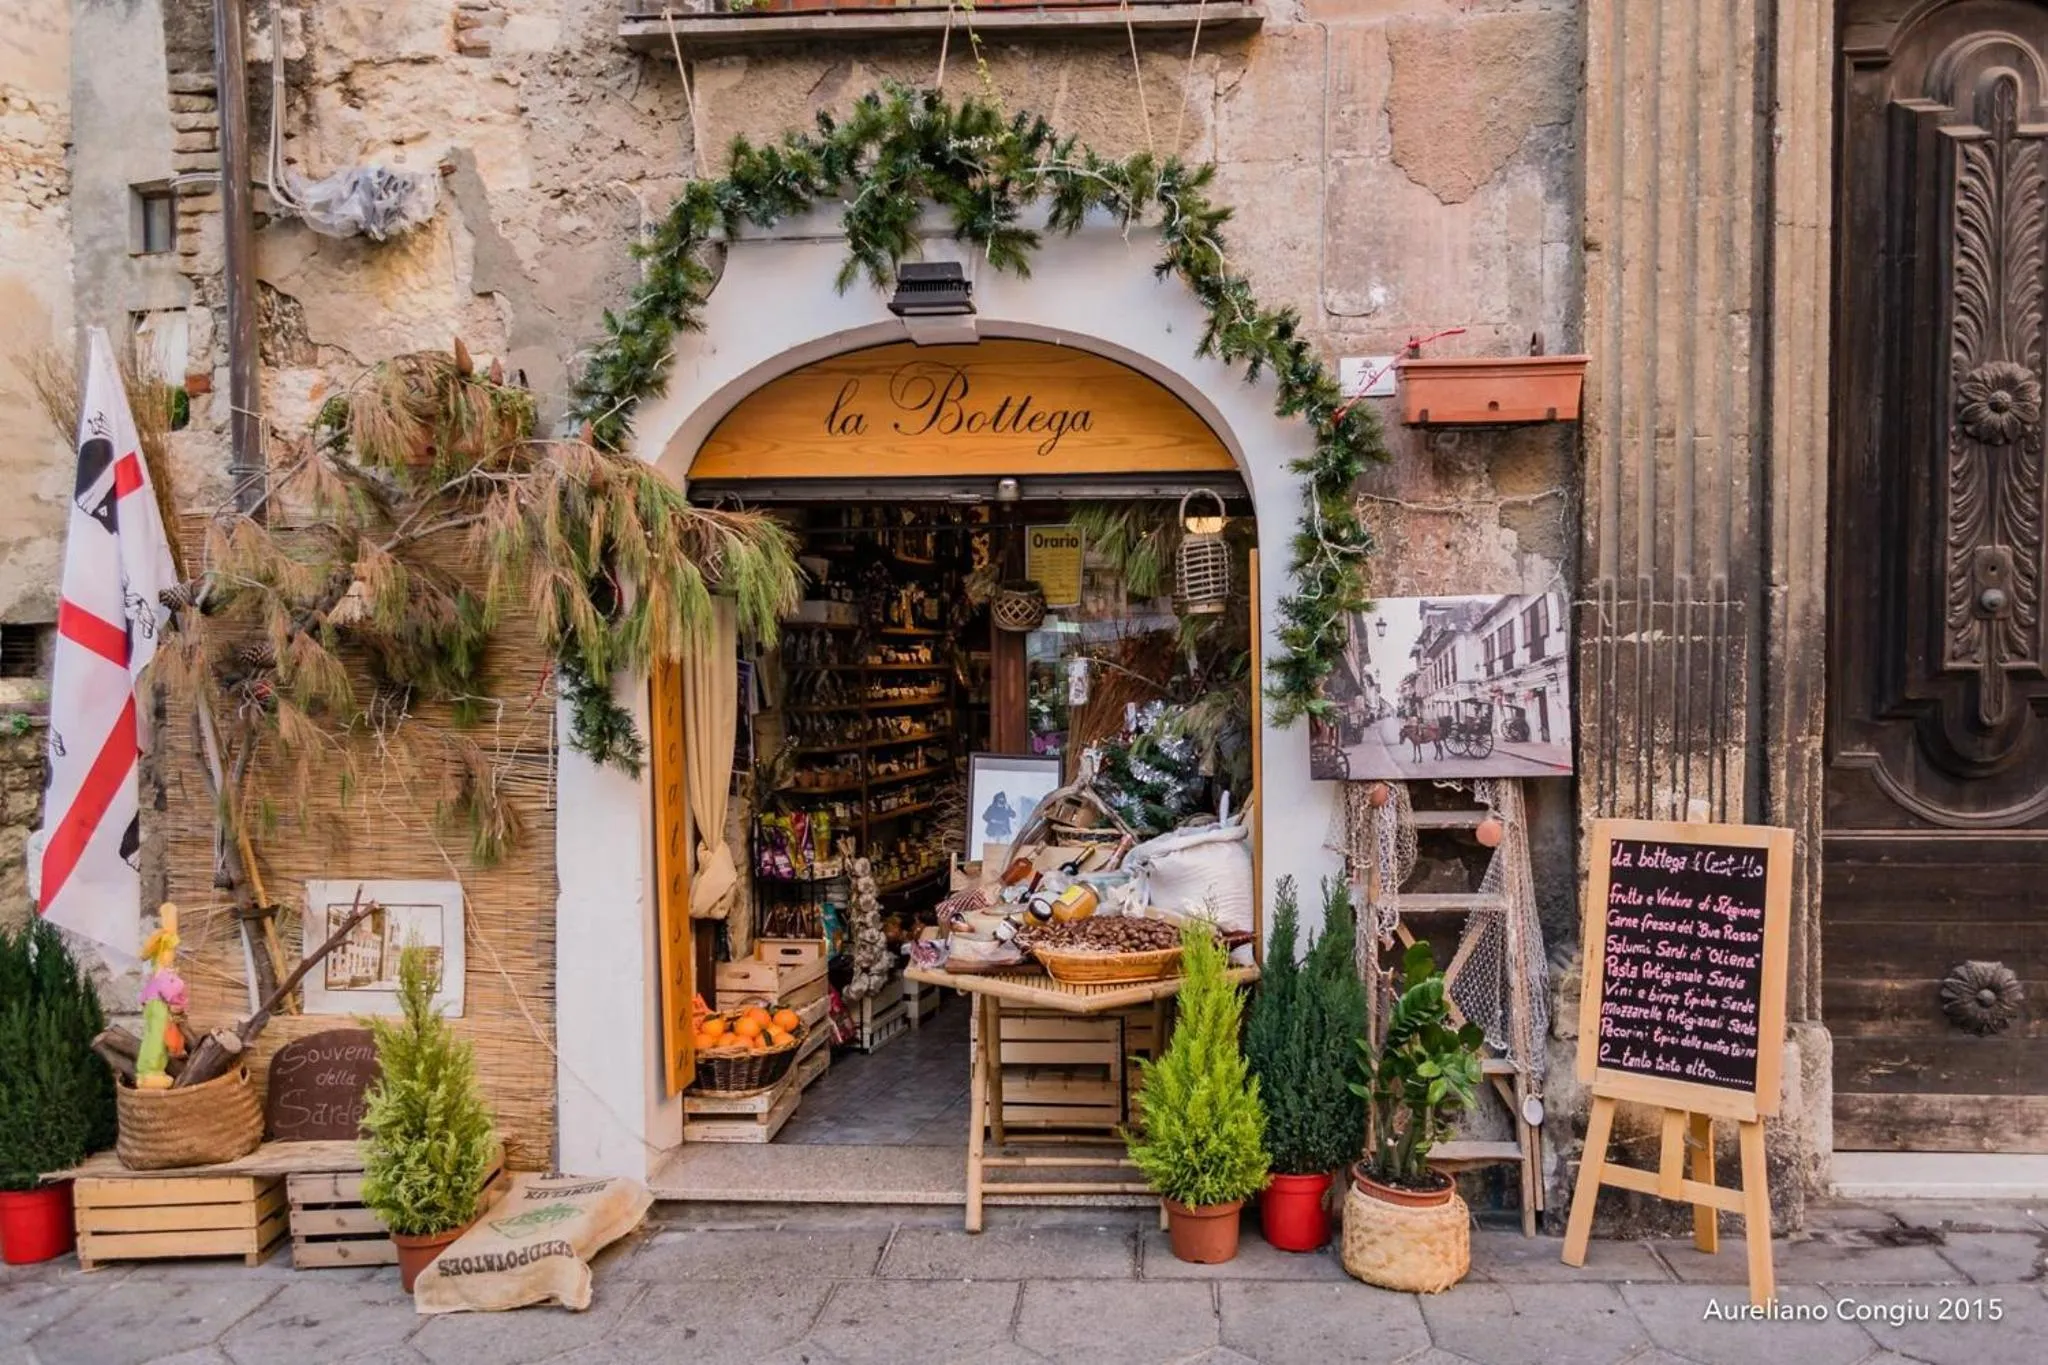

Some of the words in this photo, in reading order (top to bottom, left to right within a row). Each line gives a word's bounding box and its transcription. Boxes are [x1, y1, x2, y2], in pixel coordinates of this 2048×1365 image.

[823, 378, 870, 436] la
[889, 360, 1094, 457] Bottega
[1032, 532, 1079, 549] Orario
[1638, 844, 1688, 874] bottega
[1607, 909, 1639, 929] Carne
[1641, 913, 1676, 933] fresca
[1713, 896, 1761, 921] Stagione
[1606, 934, 1651, 955] Salumi
[1655, 940, 1688, 959] Sardi
[1605, 955, 1638, 979] Pasta
[1642, 961, 1703, 987] Artigianale
[1706, 971, 1746, 990] Sarda
[1605, 978, 1633, 997] Vini
[1637, 988, 1646, 999] e
[1648, 984, 1680, 1005] birre
[1721, 995, 1756, 1014] Sarde
[1601, 1001, 1662, 1021] Mozzarelle
[1728, 1019, 1757, 1036] Sarde
[1601, 1017, 1649, 1040] Pecorini
[275, 1043, 373, 1075] Souveni
[1622, 1045, 1652, 1067] tanto
[1655, 1053, 1682, 1074] tanto
[316, 1067, 357, 1087] della
[274, 1089, 364, 1129] Sarde
[437, 1240, 575, 1277] SEEDPOTATOES
